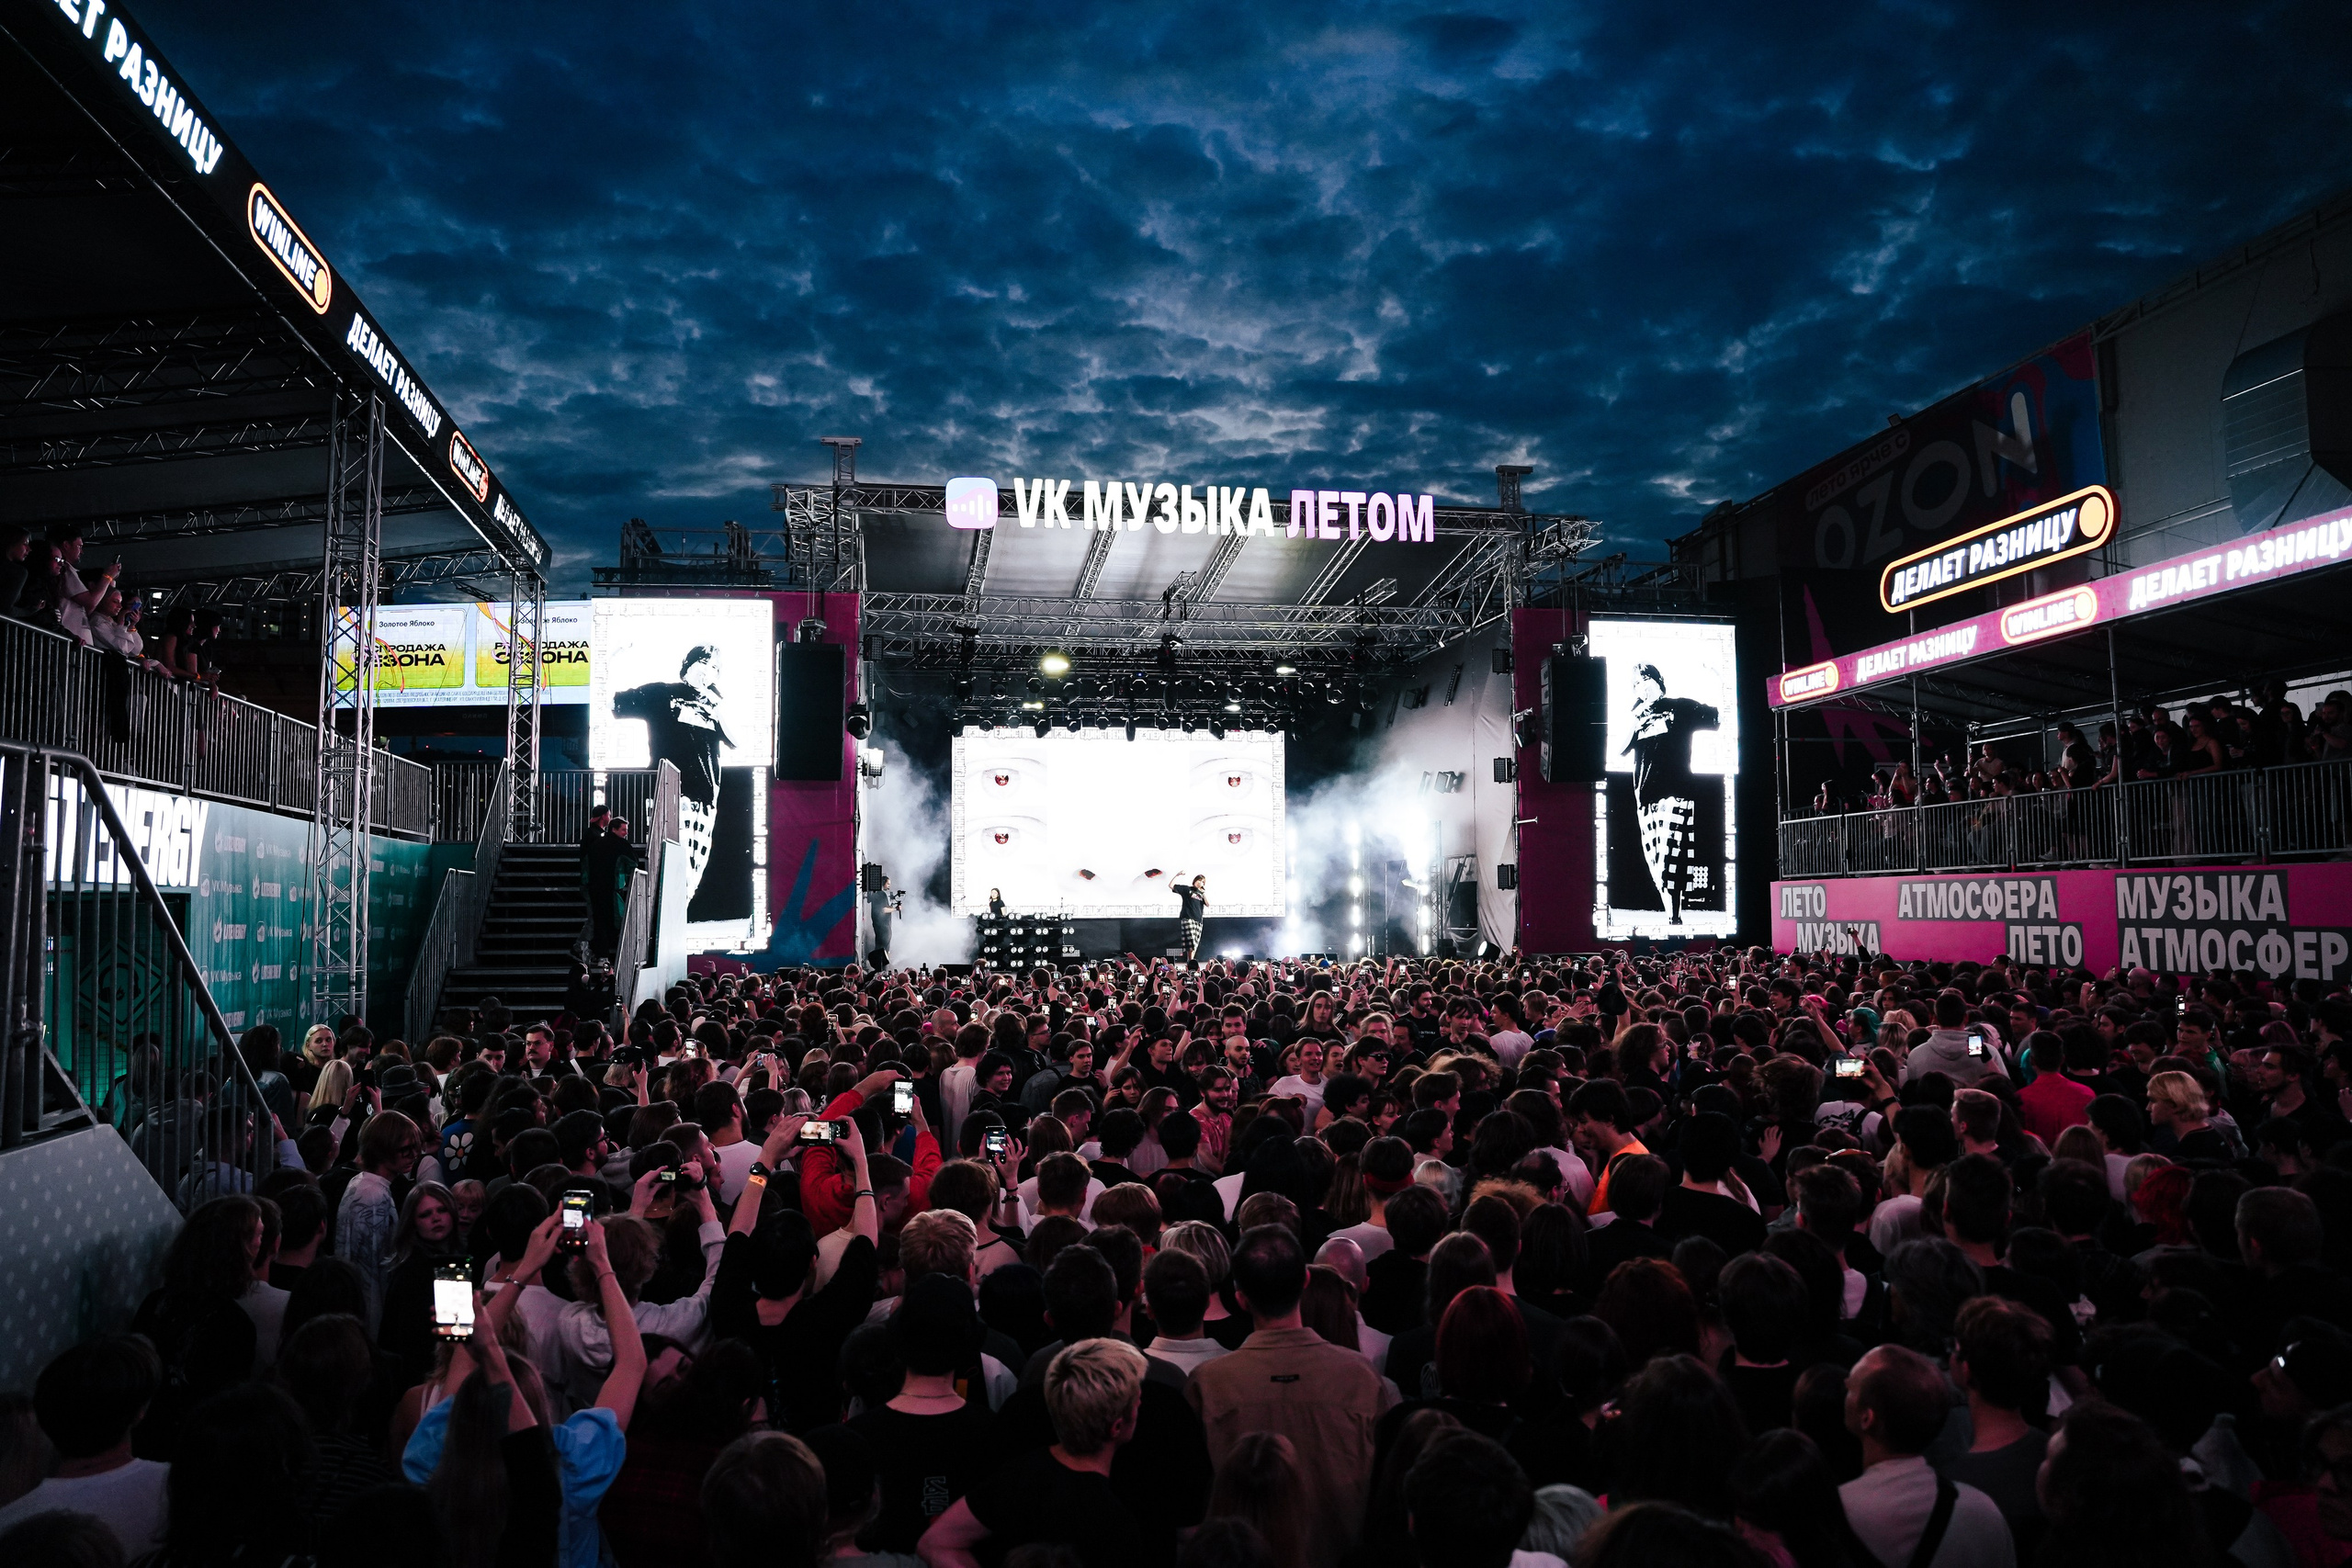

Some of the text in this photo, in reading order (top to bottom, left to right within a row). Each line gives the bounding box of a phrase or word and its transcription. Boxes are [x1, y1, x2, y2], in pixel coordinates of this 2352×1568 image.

[52, 0, 223, 175] ЕТ РАЗНИЦУ
[254, 196, 317, 290] WINLINE
[346, 311, 442, 439] ДЕЛАЕТ РАЗНИЦУ
[453, 439, 482, 490] WINLINE
[1809, 477, 1847, 506] лето
[1849, 444, 1893, 479] ярче
[1814, 391, 2039, 570] OZON
[1013, 478, 1435, 543] VK МУЗЫКА ЛЕТОМ
[1891, 508, 2076, 606] ДЕЛАЕТ РАЗНИЦУ
[2129, 517, 2352, 610] ДЕЛАЕТ РАЗНИЦУ
[409, 619, 435, 627] Яблоко
[551, 615, 579, 624] Яблоко
[2007, 598, 2075, 637] WINLINE
[1856, 625, 1977, 682] ДЕЛАЕТ РАЗНИЦУ
[1784, 671, 1826, 696] WINLINE
[85, 783, 209, 886] ENERGY
[1781, 886, 1826, 918] ЛЕТО
[1898, 879, 2057, 919] АТМОСФЕРА
[2116, 874, 2287, 921] МУЗЫКА
[2007, 925, 2083, 966] ЛЕТО
[2120, 927, 2348, 981] АТМОСФЕР
